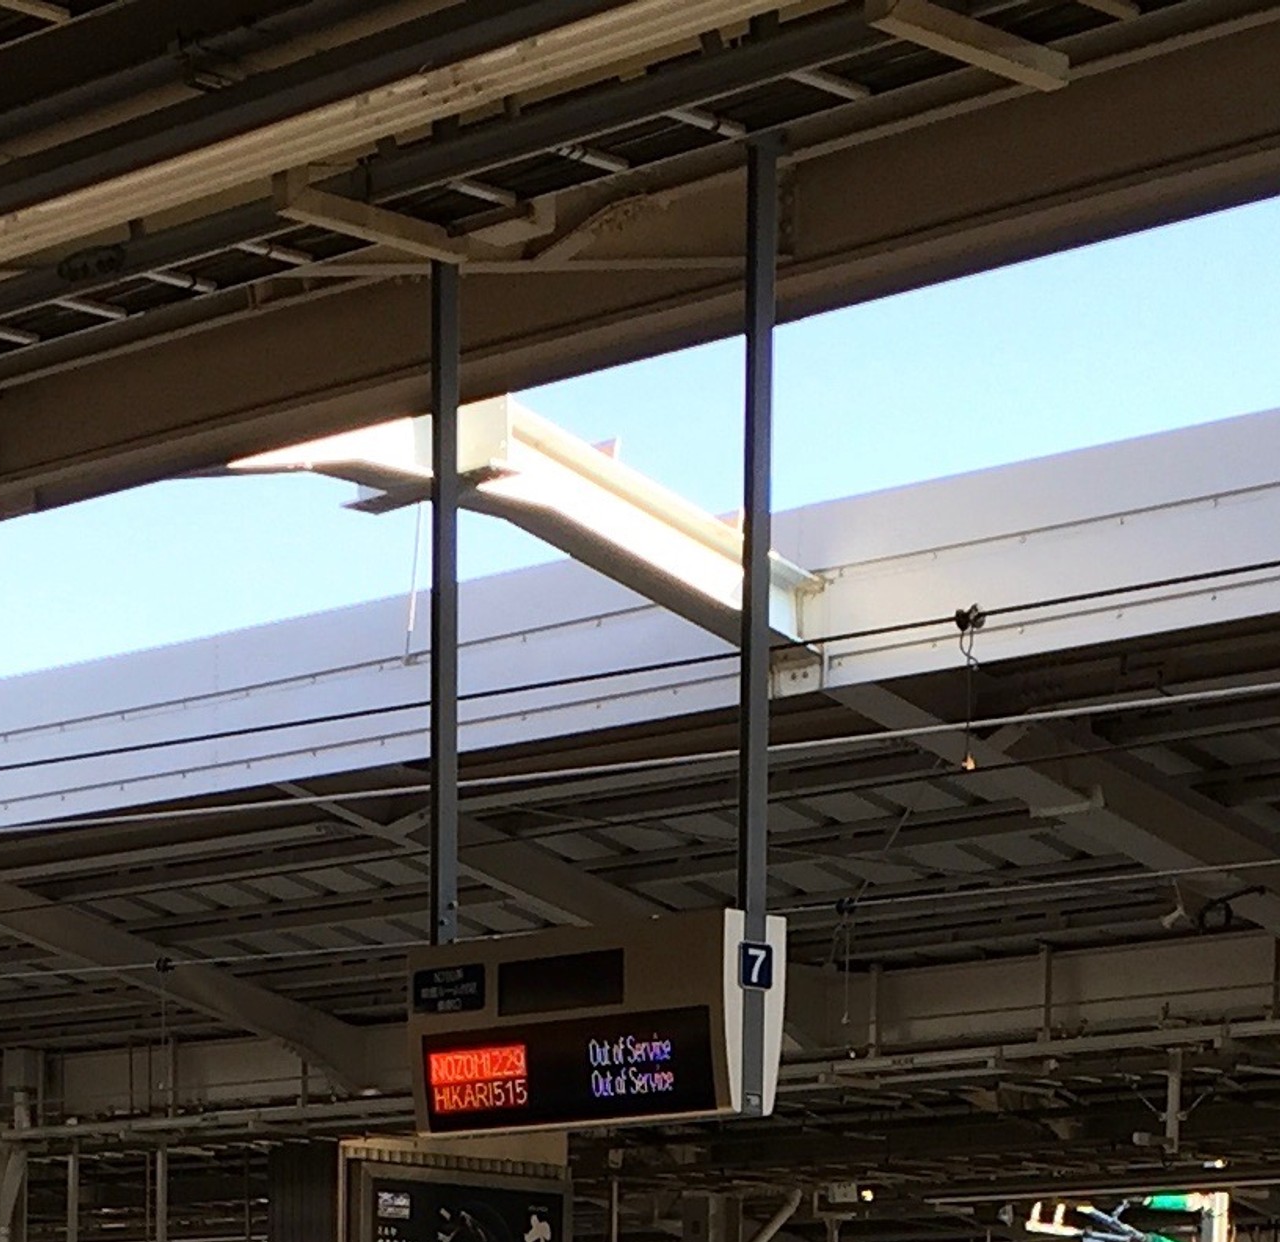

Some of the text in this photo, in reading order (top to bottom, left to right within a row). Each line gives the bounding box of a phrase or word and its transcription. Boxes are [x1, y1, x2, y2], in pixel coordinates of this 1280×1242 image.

[747, 947, 767, 984] 7
[588, 1033, 671, 1067] Out of Service
[591, 1064, 674, 1098] Out of Service
